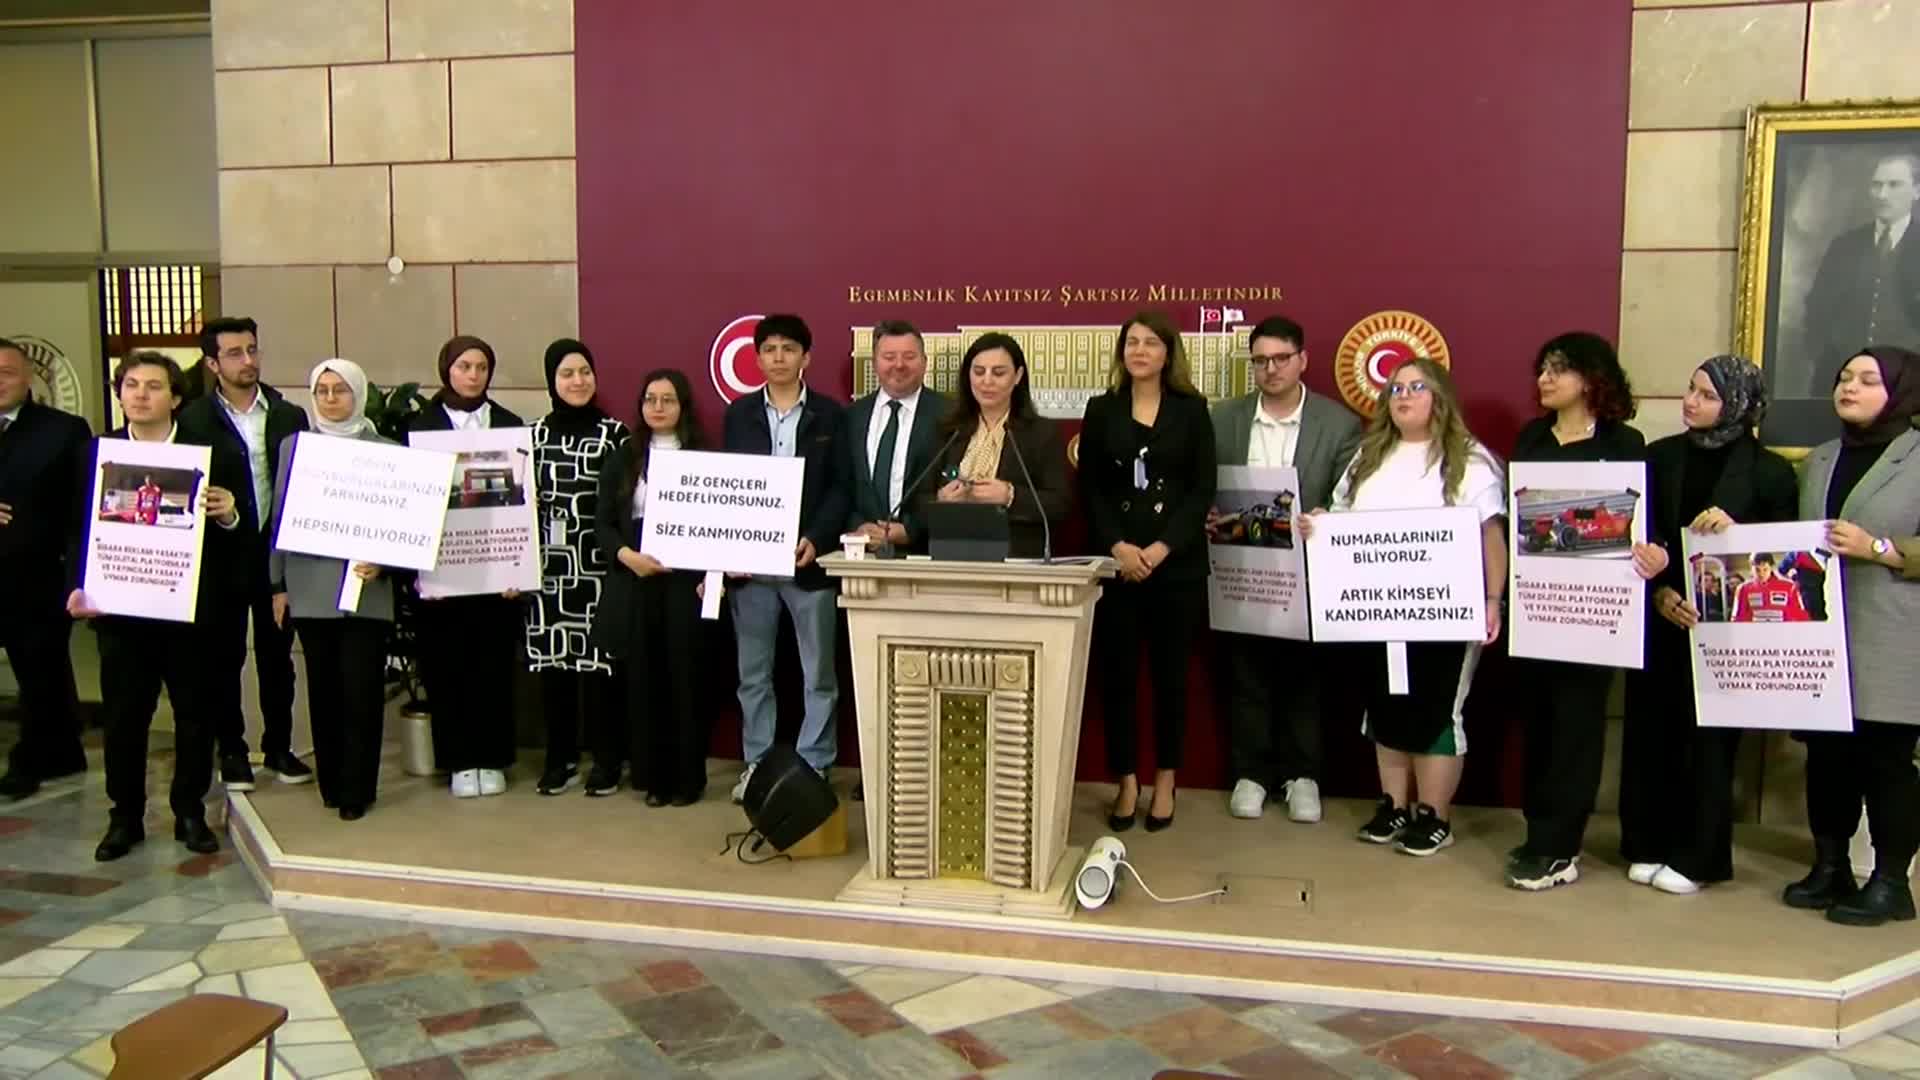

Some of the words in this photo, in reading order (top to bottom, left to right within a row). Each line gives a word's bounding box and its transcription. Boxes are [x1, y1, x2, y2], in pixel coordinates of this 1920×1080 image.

[965, 285, 1051, 302] KAYITSIZ
[1060, 285, 1140, 307] ŞARTSIZ
[680, 473, 700, 486] BİZ
[702, 476, 767, 492] GENÇLERİ
[658, 490, 785, 509] HEDEFLİYORSUNUZ.
[655, 521, 685, 537] SİZE
[688, 526, 785, 543] KANMIYORUZ!
[1330, 530, 1454, 547] NUMARALARINIZI
[1353, 548, 1432, 564] BİLİYORUZ.
[1340, 588, 1384, 602] ARTIK
[1387, 584, 1451, 601] KİMSEYİ
[1325, 607, 1474, 622] KANDIRAMAZSINIZ!
